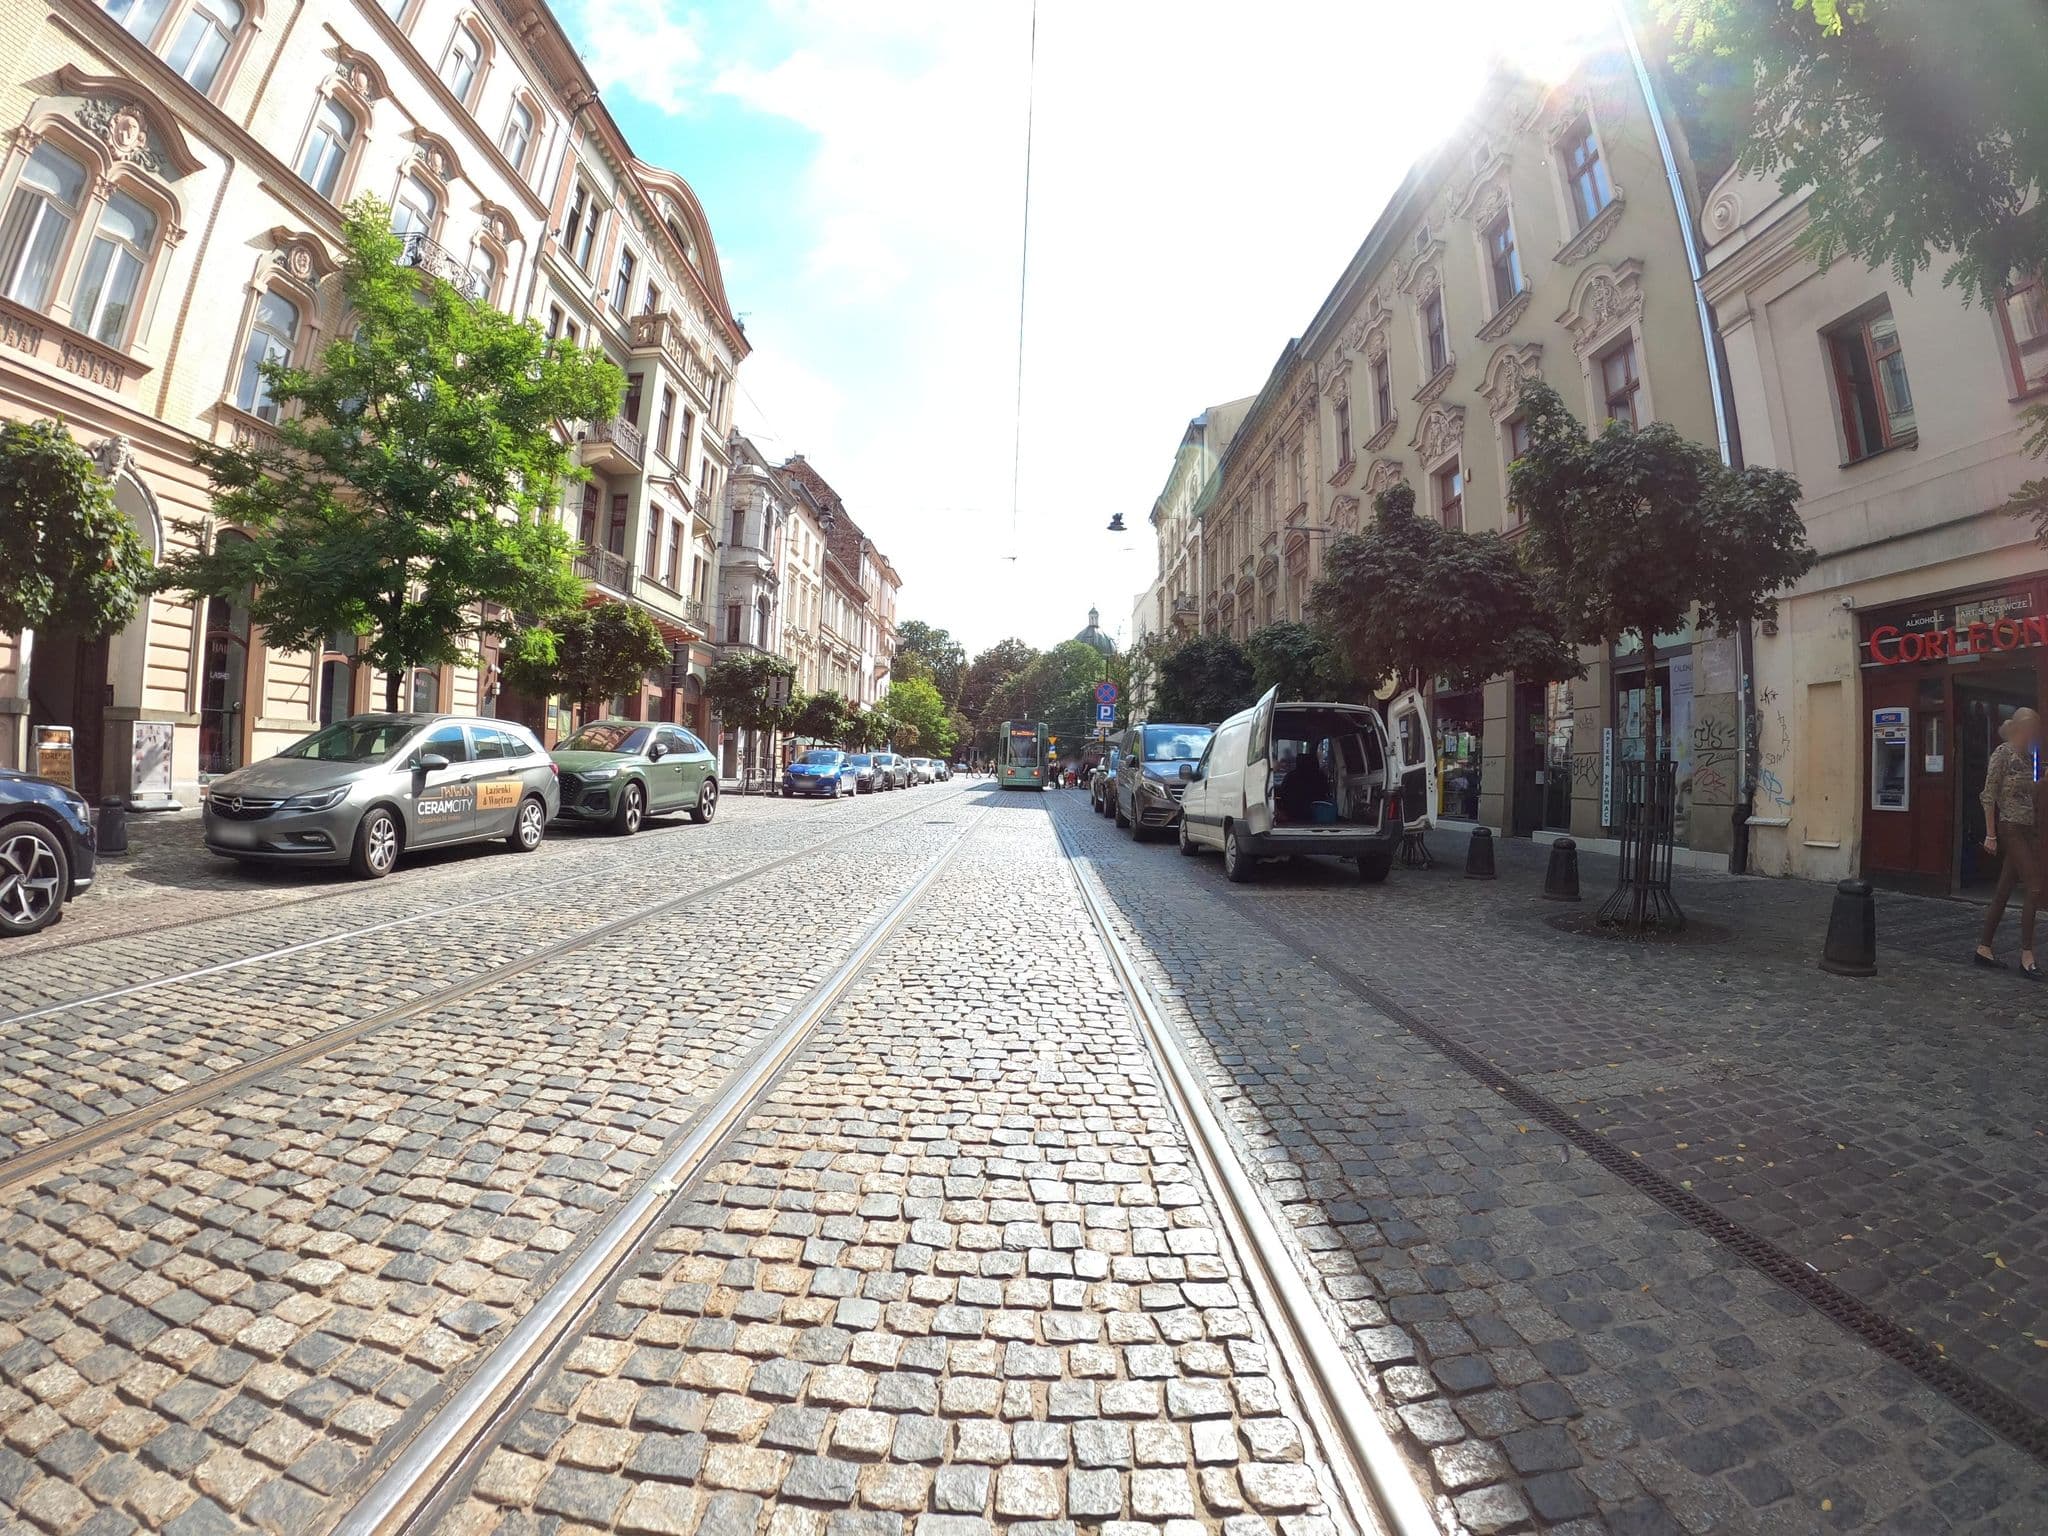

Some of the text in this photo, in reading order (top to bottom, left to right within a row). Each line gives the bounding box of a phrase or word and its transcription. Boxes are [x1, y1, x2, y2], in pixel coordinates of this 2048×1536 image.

[1978, 600, 2028, 615] SPOŻWCZE
[1906, 614, 1945, 627] ALKOHOLE
[1100, 706, 1111, 720] P
[418, 799, 473, 815] CERAMCITY
